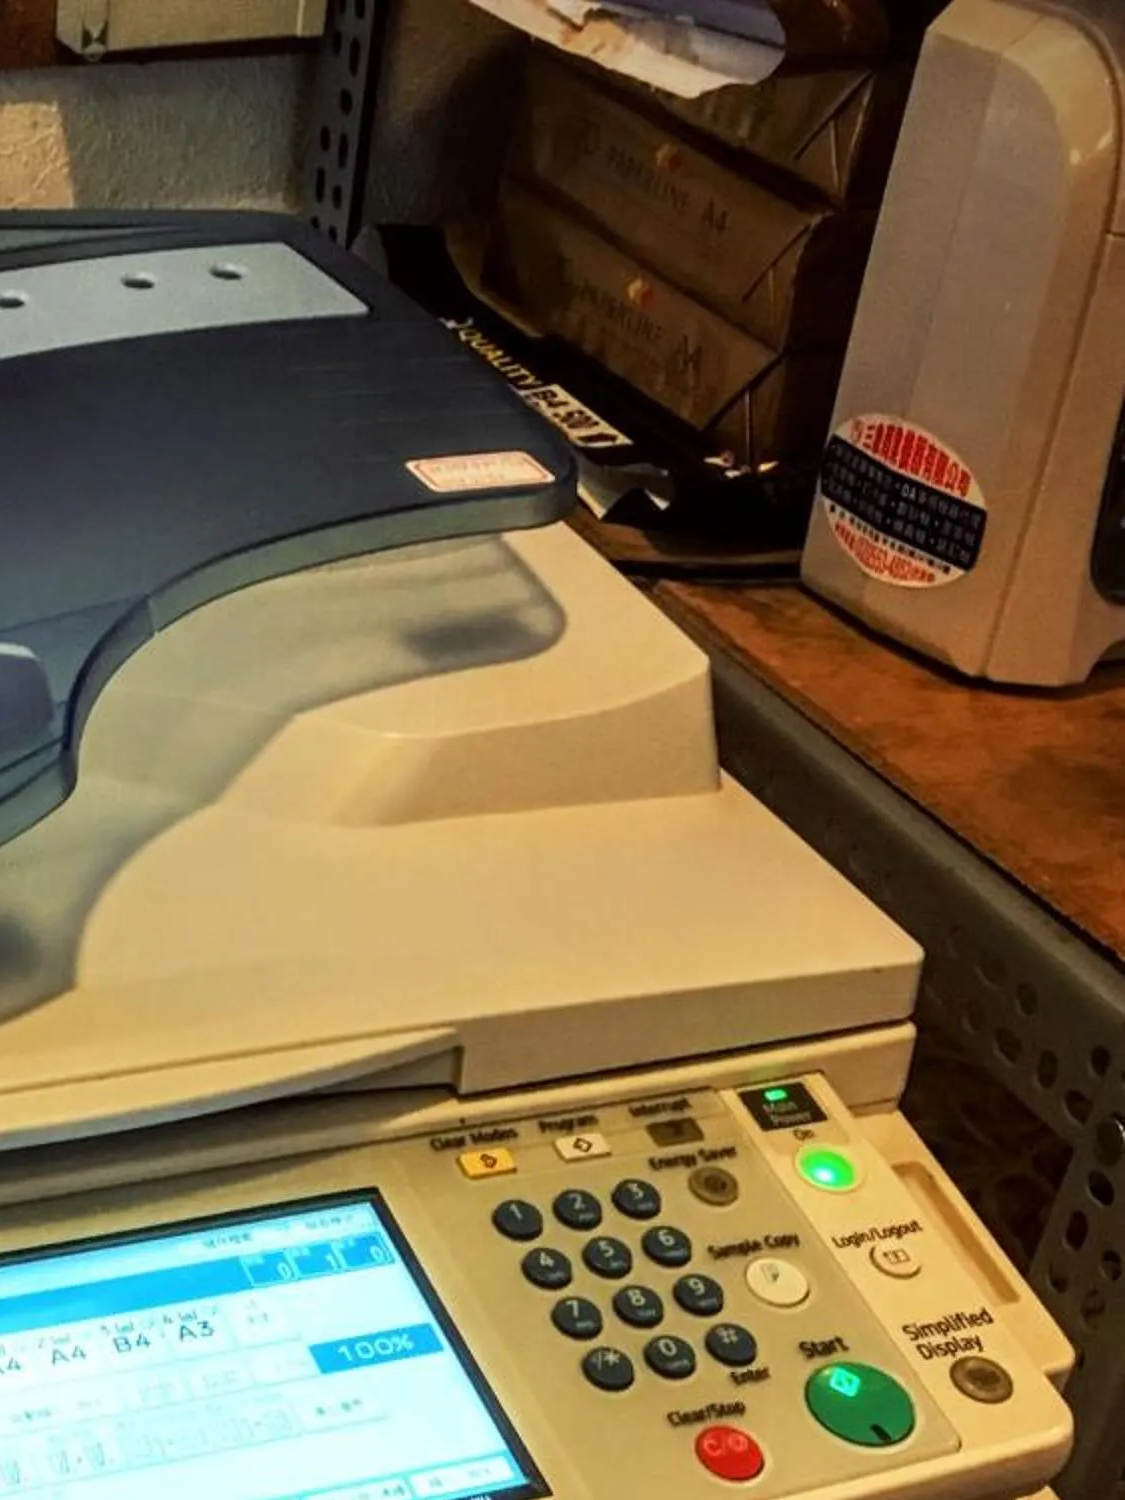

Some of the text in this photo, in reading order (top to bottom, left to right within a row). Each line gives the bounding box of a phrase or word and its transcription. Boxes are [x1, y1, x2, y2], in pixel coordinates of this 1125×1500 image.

[628, 1098, 693, 1117] Interrupt
[538, 1114, 599, 1134] Program
[430, 1128, 519, 1151] Clear Modes
[648, 1145, 738, 1170] Energy Saver
[568, 1193, 586, 1210] 2
[627, 1183, 644, 1200] 3
[509, 1203, 524, 1220] 1
[658, 1229, 675, 1247] 6
[831, 1220, 924, 1249] Login/Logout
[599, 1240, 615, 1258] 5
[708, 1239, 762, 1260] Sample
[764, 1232, 801, 1250] Copy
[539, 1252, 555, 1267] 4
[687, 1277, 706, 1296] 9
[627, 1289, 646, 1306] 8
[566, 1299, 580, 1318] 7
[179, 1320, 216, 1342] A3
[901, 1306, 995, 1342] Simplified
[112, 1333, 152, 1354] B4
[337, 1332, 415, 1362] 100%
[658, 1339, 678, 1357] 0
[798, 1336, 850, 1360] Start
[915, 1334, 985, 1361] Display
[49, 1345, 88, 1366] A4
[730, 1367, 771, 1385] Enter
[666, 1402, 747, 1427] Clear/Stop
